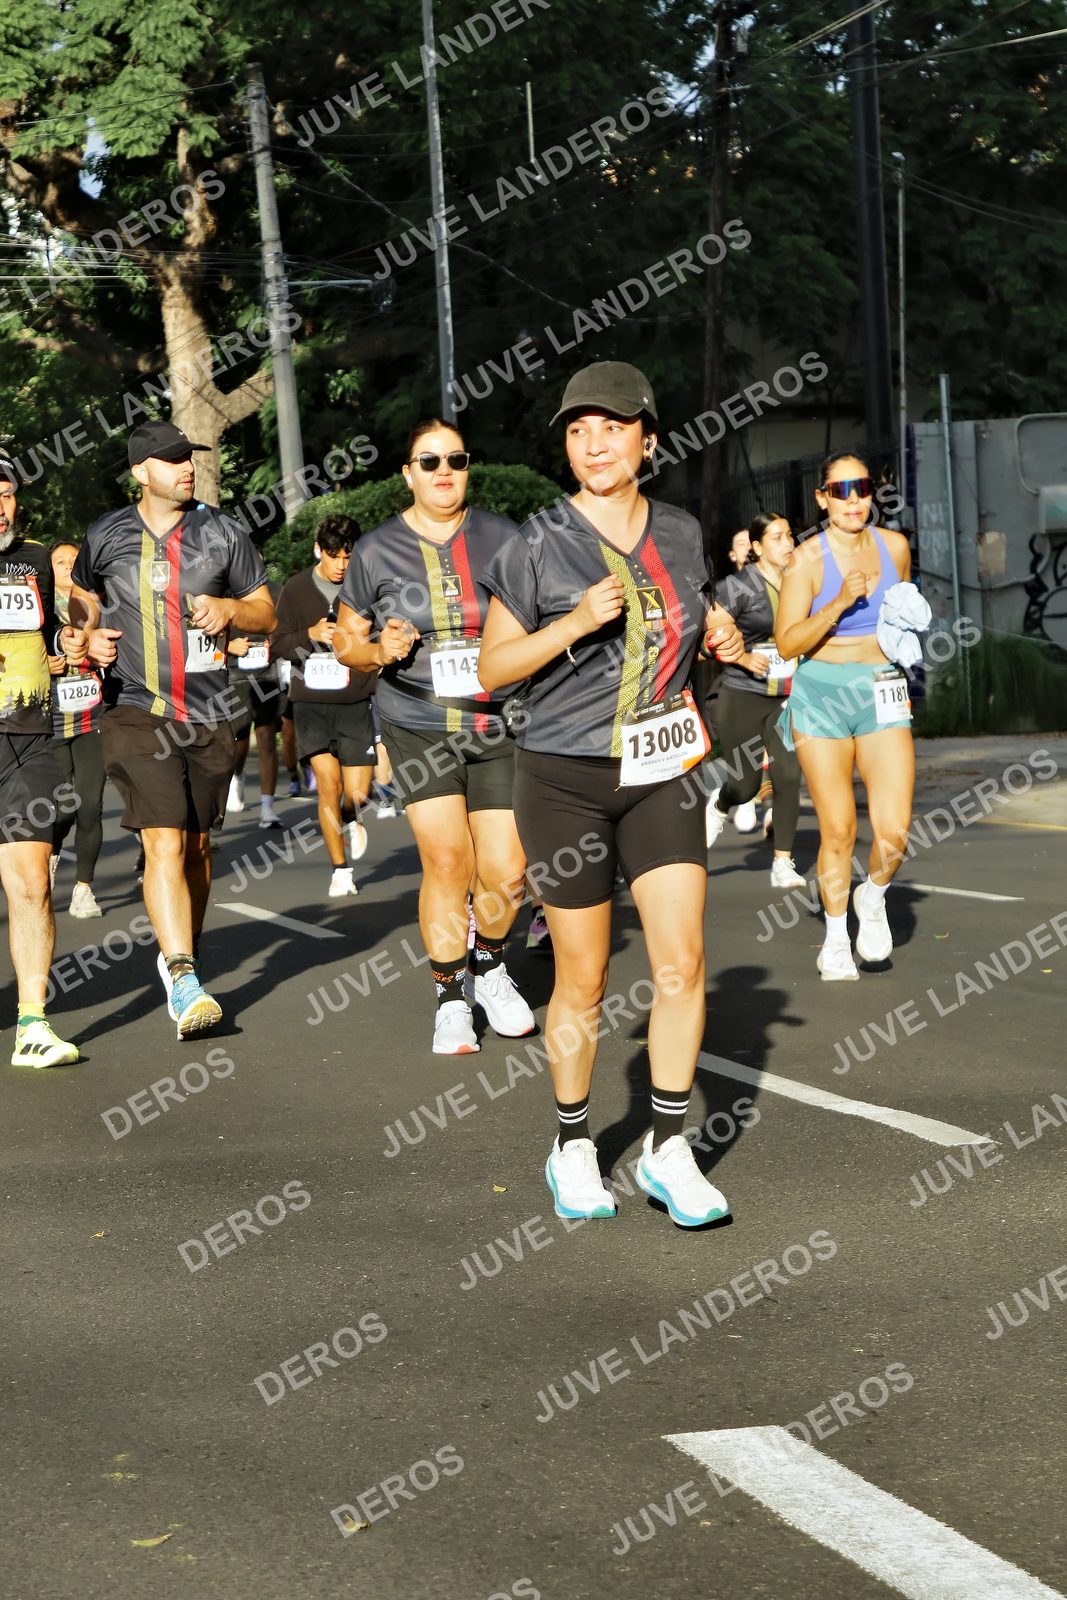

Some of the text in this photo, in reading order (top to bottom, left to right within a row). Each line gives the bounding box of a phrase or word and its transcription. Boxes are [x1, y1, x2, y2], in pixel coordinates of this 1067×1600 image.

[0, 593, 34, 610] 795
[310, 664, 340, 676] 8352
[61, 684, 97, 700] 12826
[628, 717, 698, 760] 13008
